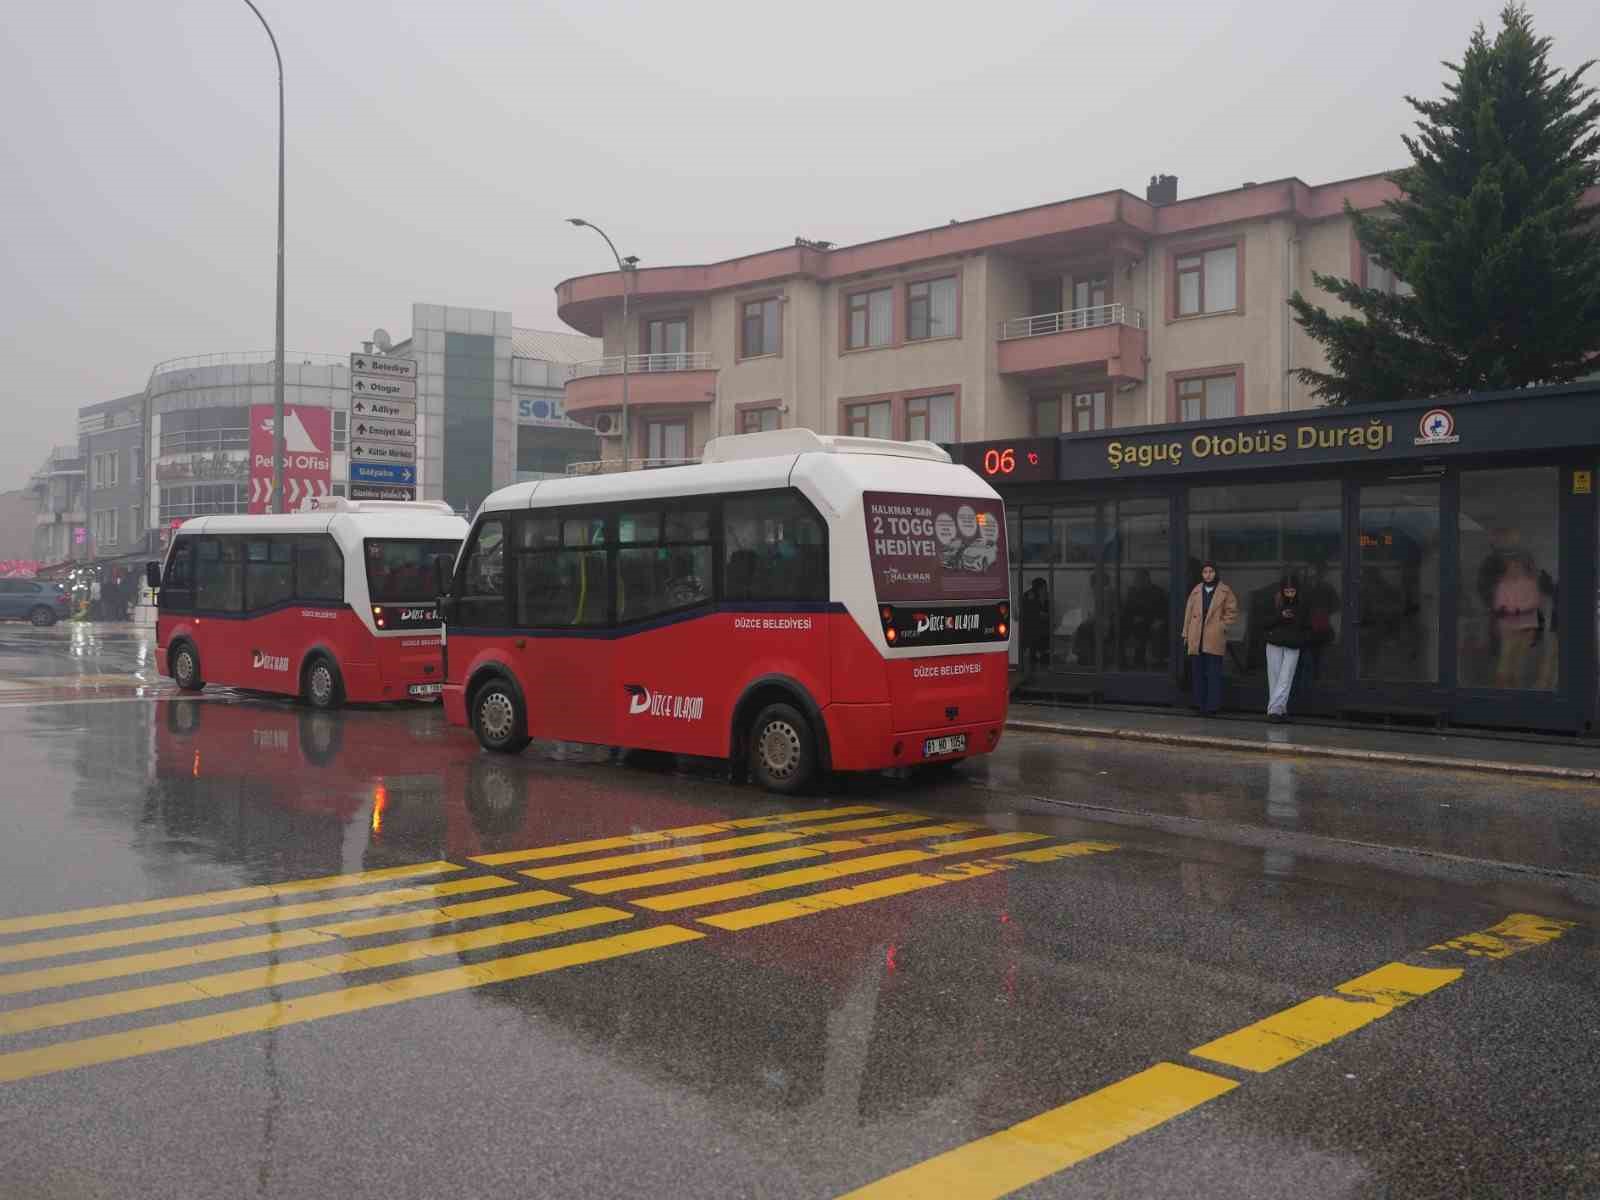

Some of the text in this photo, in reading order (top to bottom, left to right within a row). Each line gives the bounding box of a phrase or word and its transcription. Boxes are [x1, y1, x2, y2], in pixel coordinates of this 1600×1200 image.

[371, 383, 400, 394] Otogar
[1107, 417, 1393, 469] Şaguç Otobüs Durağı
[295, 455, 329, 471] Ofisi
[984, 448, 1016, 475] 06
[873, 515, 884, 535] 2
[888, 517, 934, 536] TOGG
[875, 536, 936, 556] HEDİYE!
[734, 616, 812, 629] DÜZCE BELEDİYESİ
[913, 663, 982, 678] DÜZCE BELEDİYESİ
